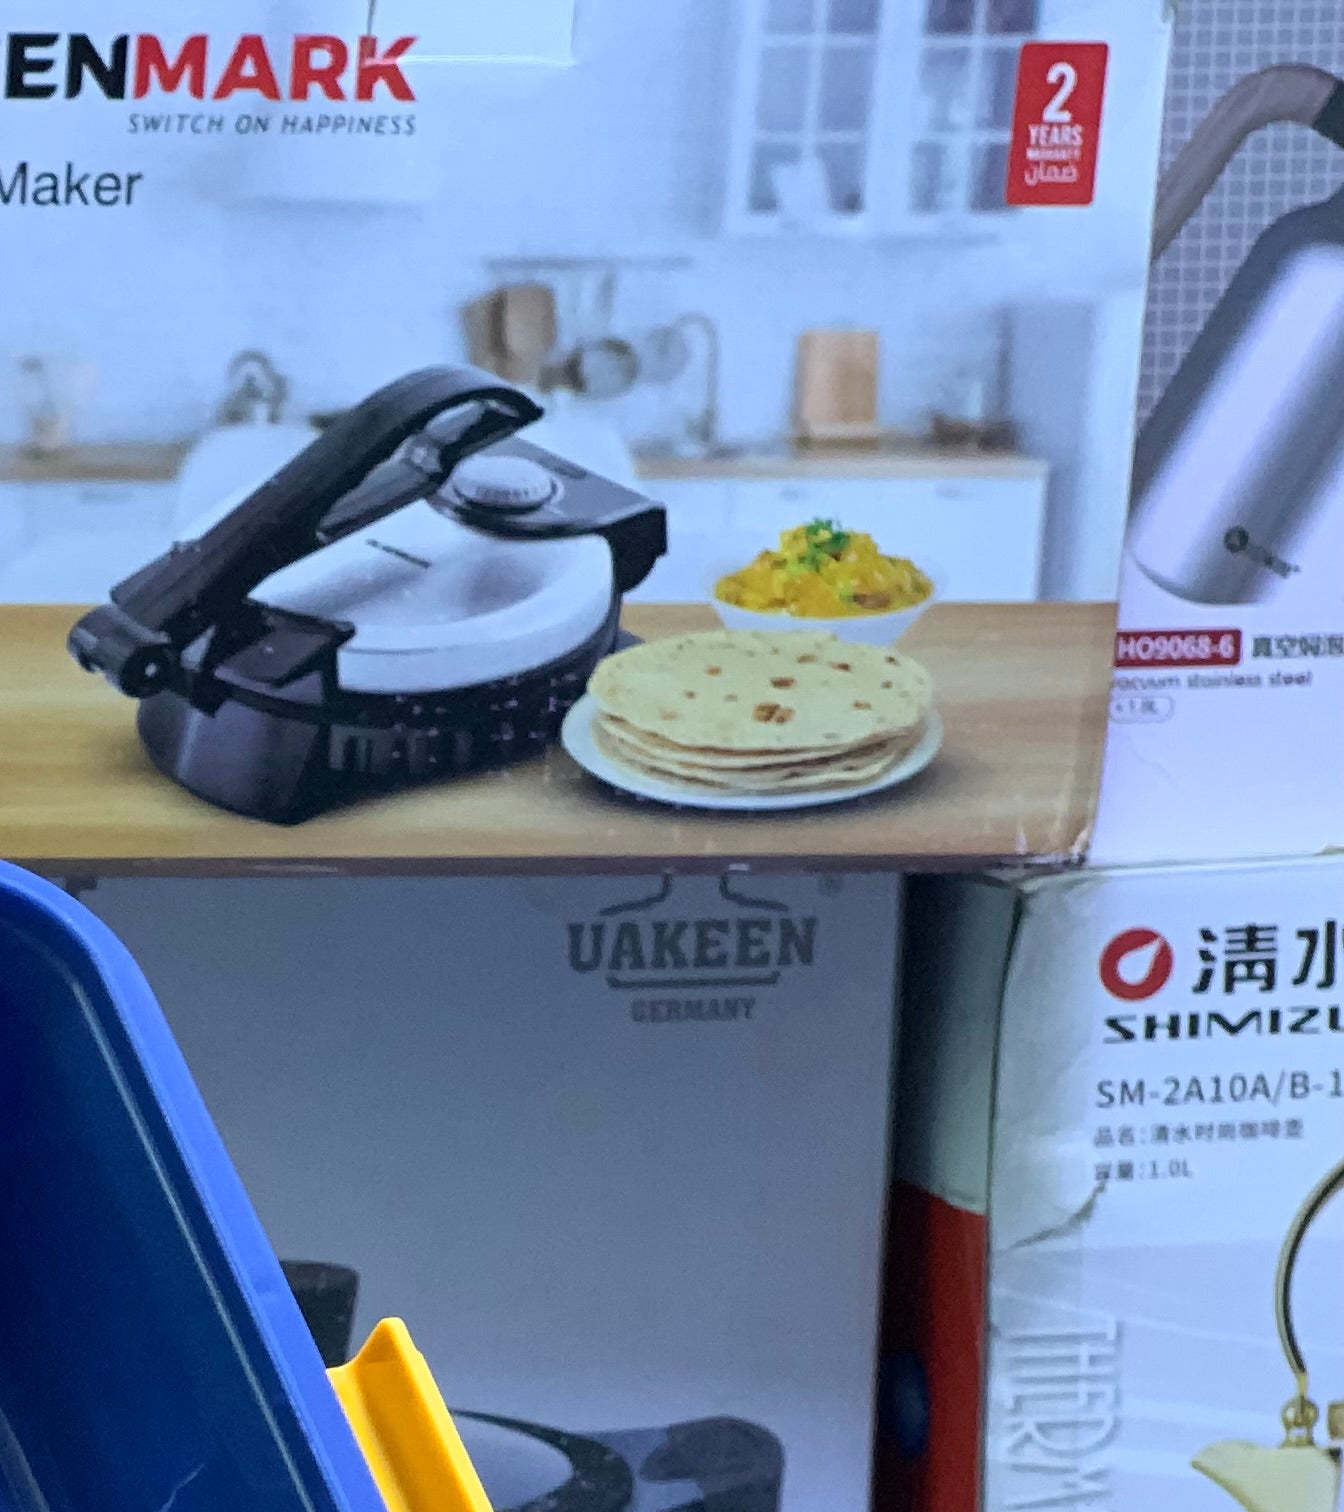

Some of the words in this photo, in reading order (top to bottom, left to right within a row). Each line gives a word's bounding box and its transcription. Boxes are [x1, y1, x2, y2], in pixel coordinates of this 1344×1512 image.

[1042, 62, 1077, 122] 2
[127, 113, 222, 134] SWITCH
[235, 114, 270, 134] ON
[280, 114, 418, 136] HAPPINESS
[1028, 124, 1083, 146] YEARS
[1269, 671, 1313, 686] steel
[567, 917, 818, 971] UAKEEN
[631, 998, 756, 1023] GERMANY
